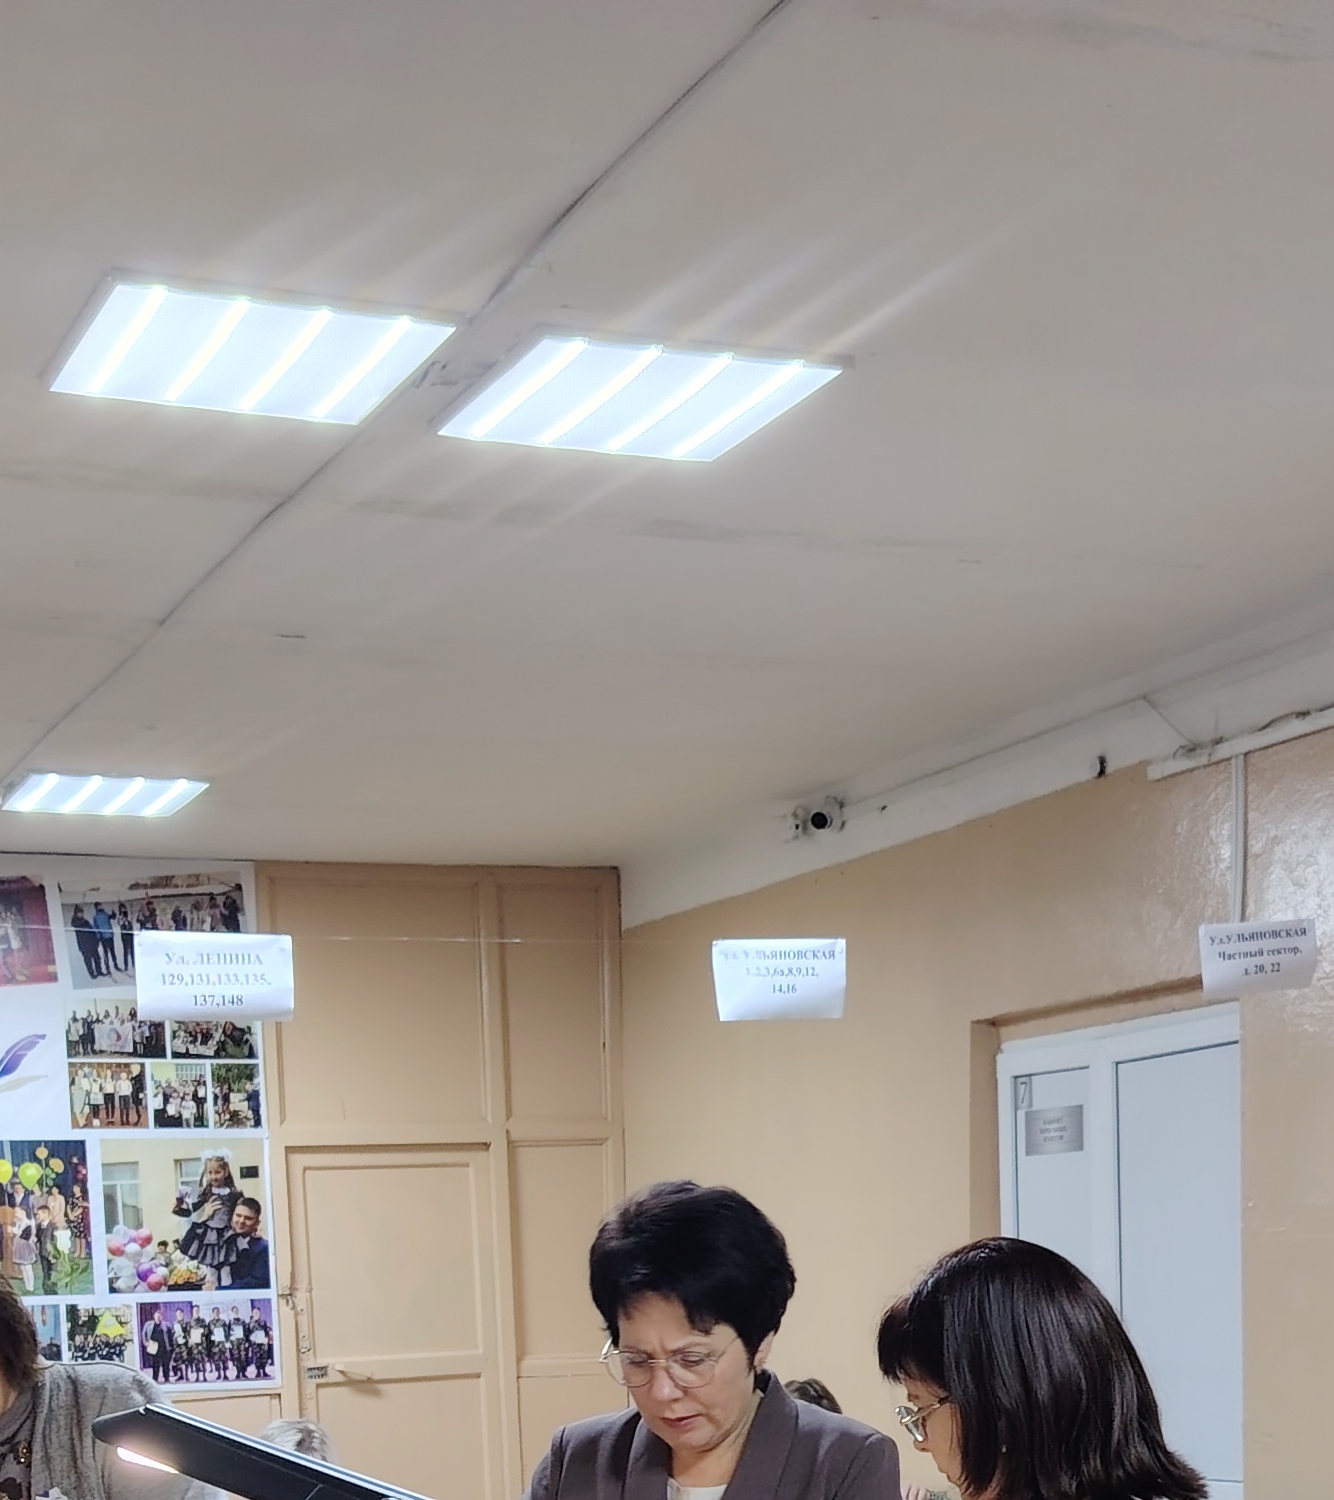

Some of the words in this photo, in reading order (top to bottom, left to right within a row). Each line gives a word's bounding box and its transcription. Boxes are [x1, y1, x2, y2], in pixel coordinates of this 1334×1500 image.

[192, 952, 264, 966] ЛЕНИНА
[1218, 948, 1264, 961] Частный
[772, 984, 797, 995] 14,16
[192, 994, 244, 1008] 137,148
[1020, 1081, 1028, 1104] 7
